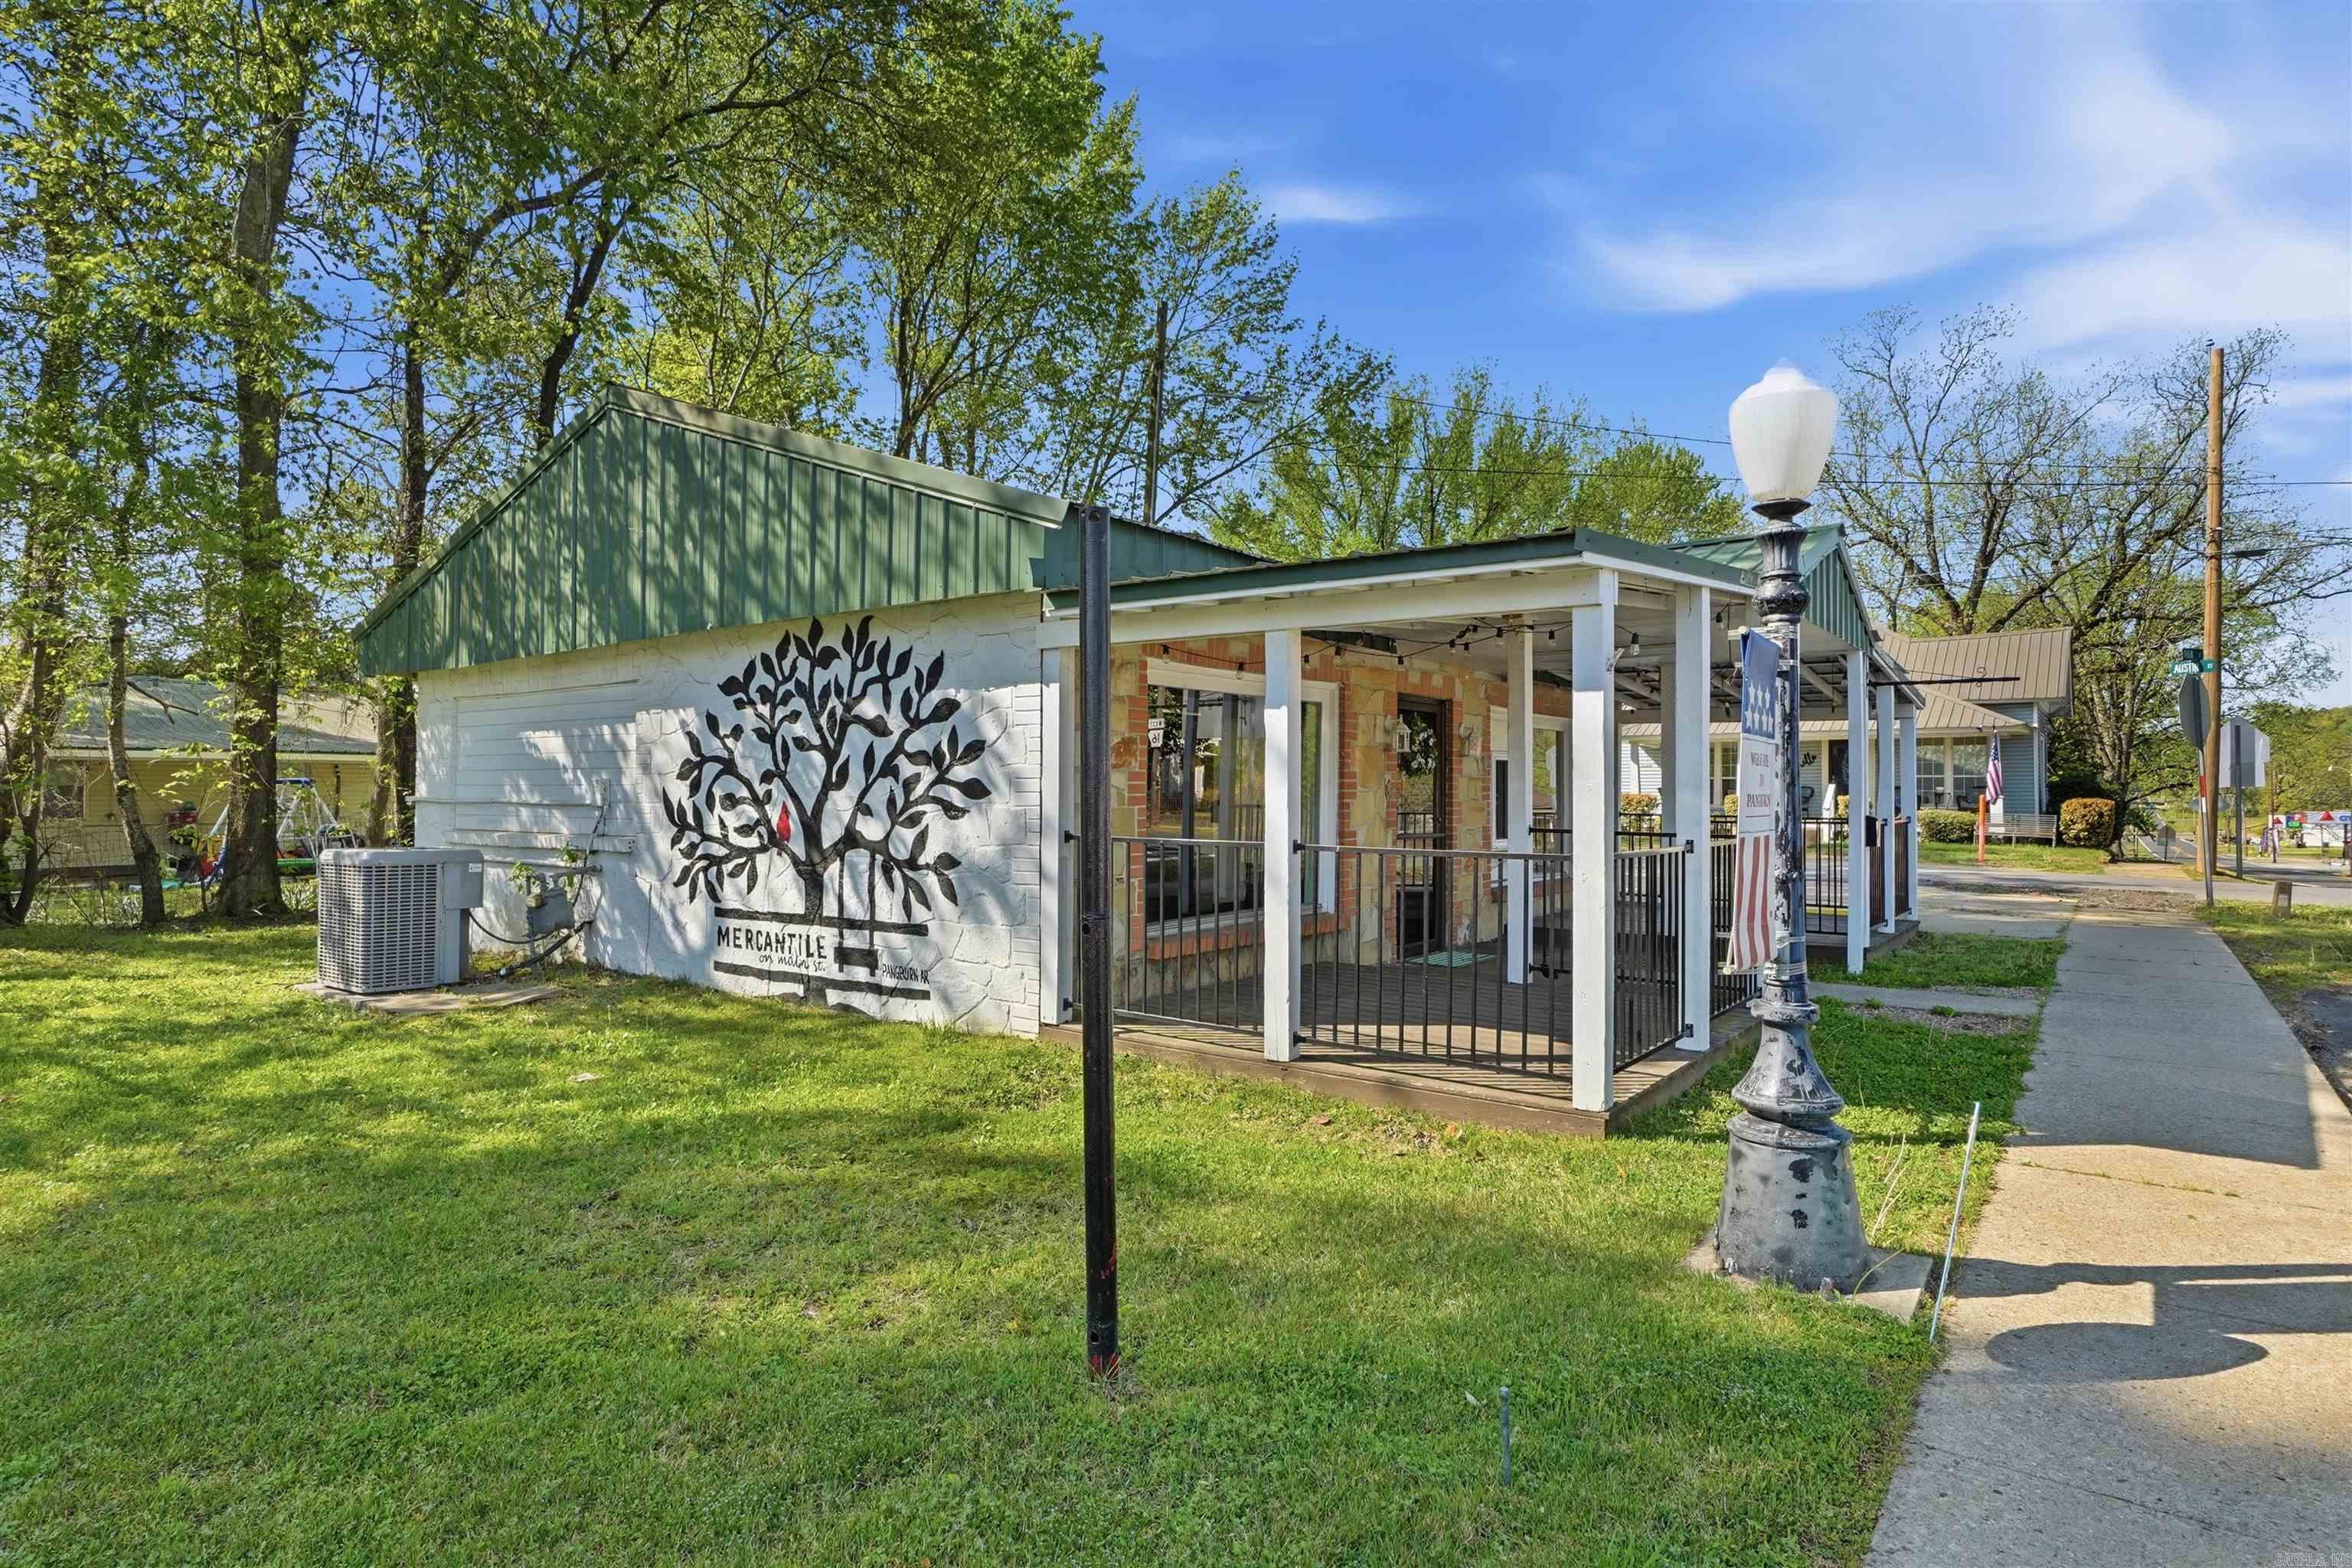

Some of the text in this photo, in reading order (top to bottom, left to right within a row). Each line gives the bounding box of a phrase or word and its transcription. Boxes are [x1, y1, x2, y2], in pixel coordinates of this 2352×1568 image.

[2174, 662, 2199, 674] AUSTIN
[717, 925, 827, 959] MERCANTILE
[760, 954, 773, 963] on
[882, 963, 930, 985] PANGBURN AR
